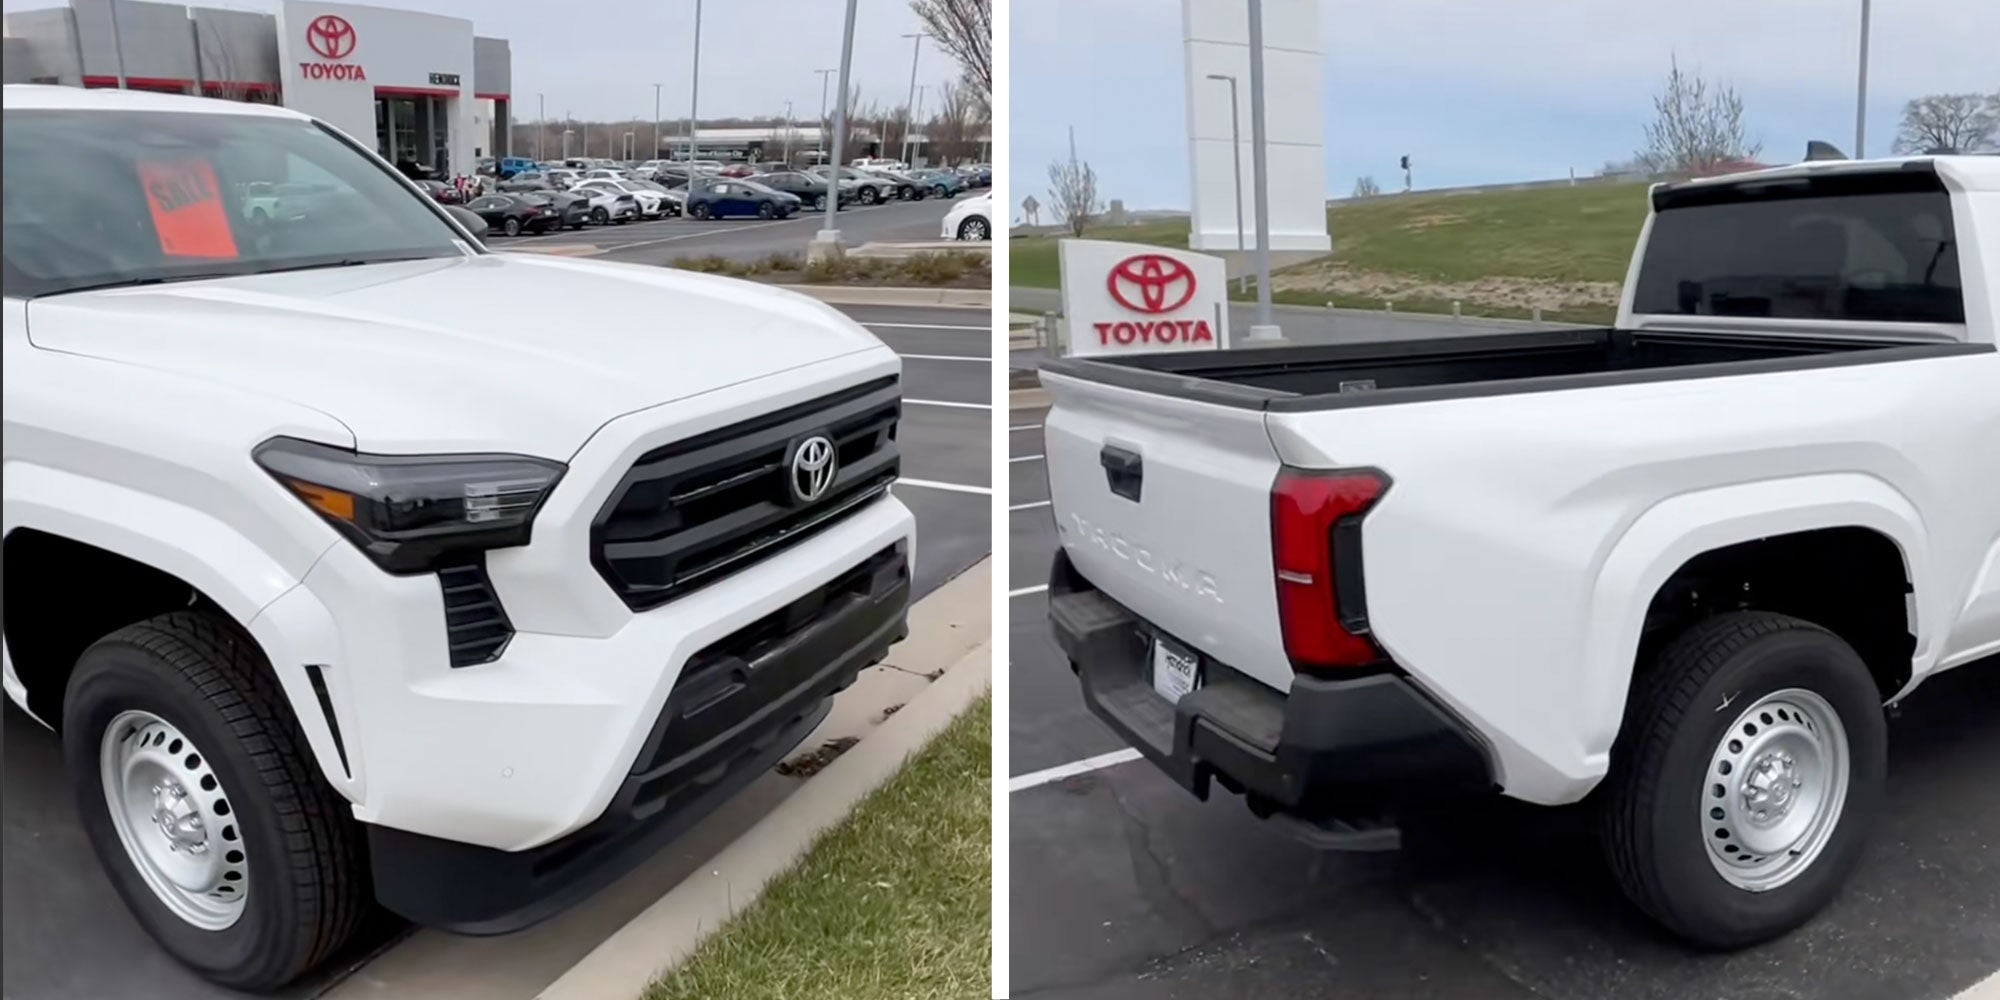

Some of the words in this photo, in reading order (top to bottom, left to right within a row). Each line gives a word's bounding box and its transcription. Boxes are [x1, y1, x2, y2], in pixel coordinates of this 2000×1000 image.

[299, 63, 366, 81] TOYOTA
[149, 166, 214, 213] SALE
[1093, 320, 1213, 345] TOYOTA
[1071, 512, 1224, 603] TACOMA
